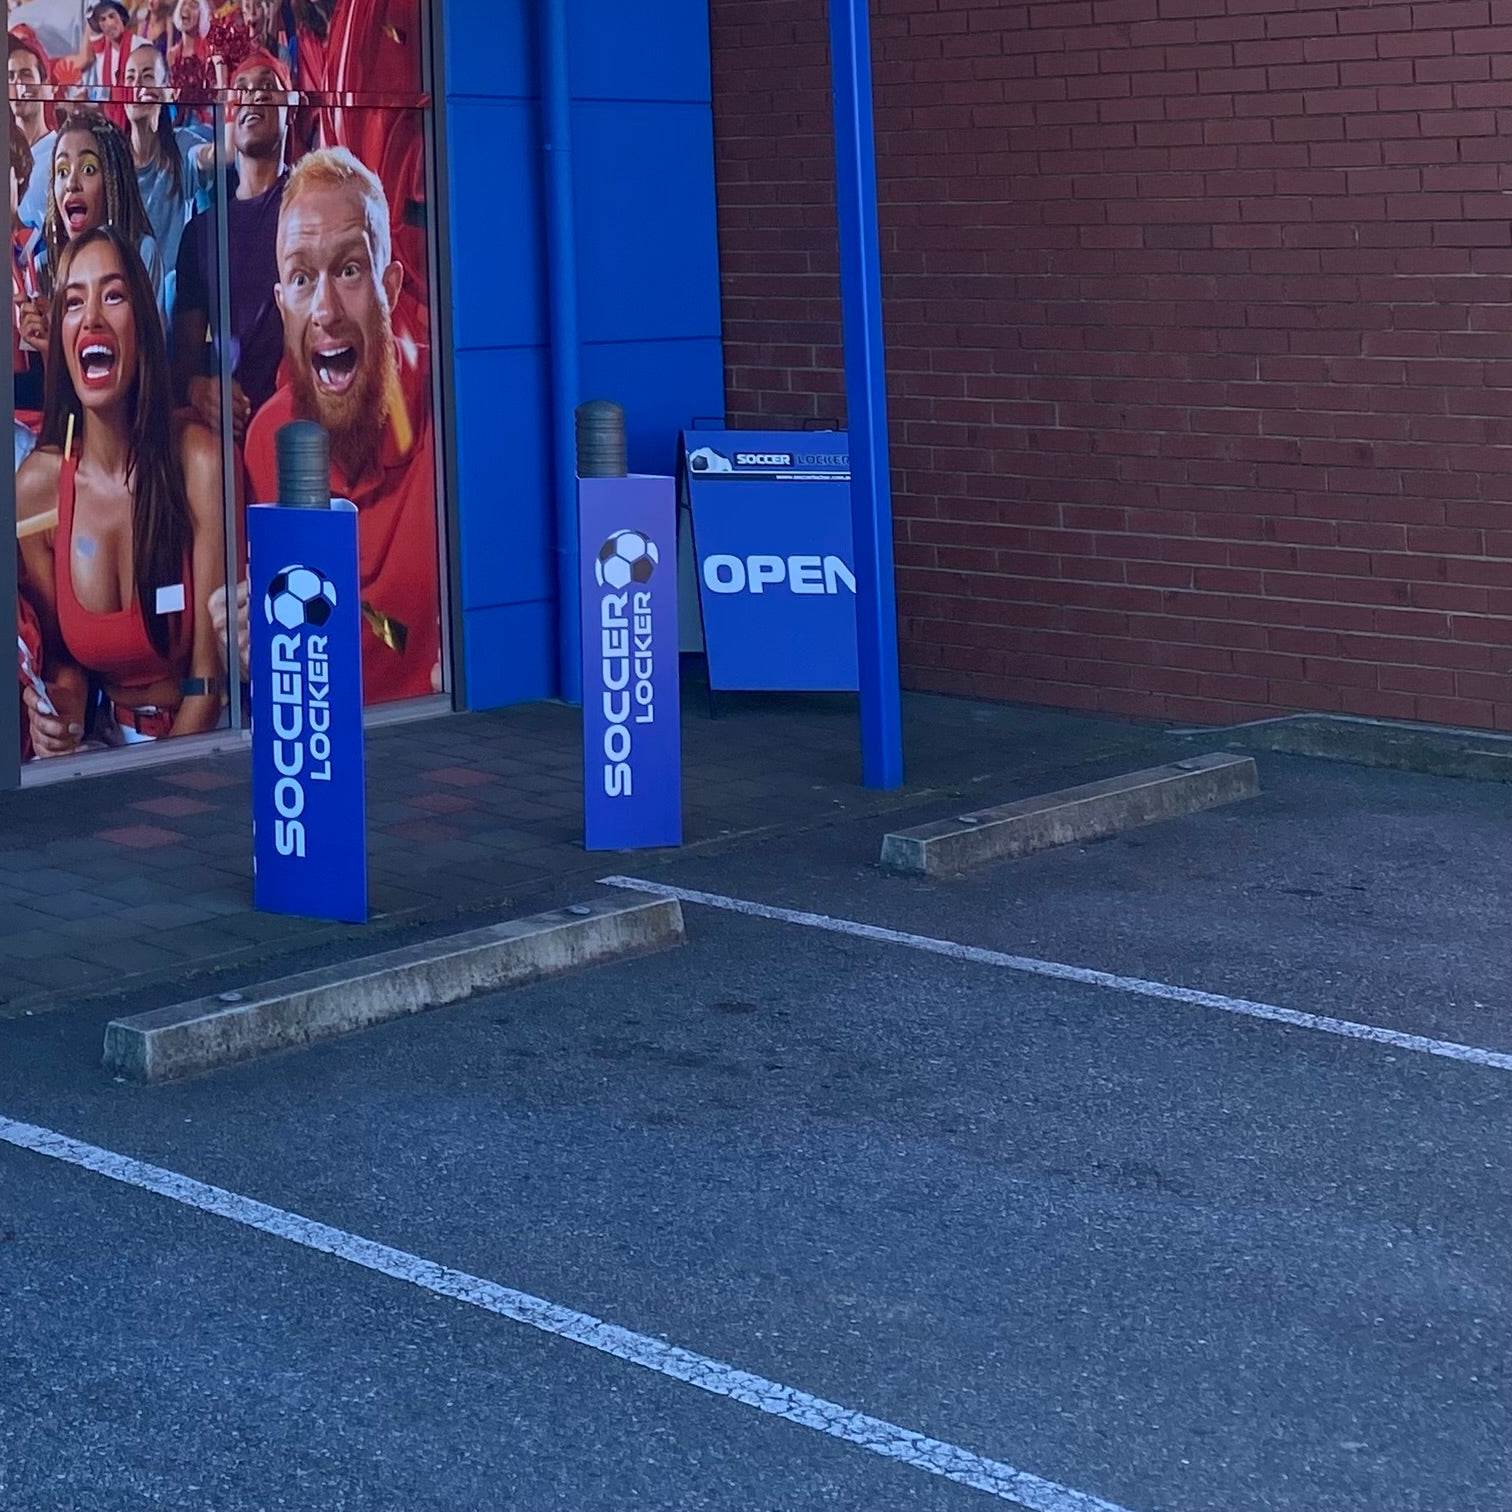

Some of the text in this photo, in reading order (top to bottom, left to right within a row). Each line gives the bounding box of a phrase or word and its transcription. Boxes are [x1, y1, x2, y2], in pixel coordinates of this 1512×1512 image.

[736, 454, 790, 465] SOCCER
[703, 554, 856, 594] OPEN
[307, 634, 332, 782] LOCKER
[601, 591, 632, 797] SOCCER
[634, 591, 654, 724] LOCKER
[271, 633, 306, 858] SOCCER
